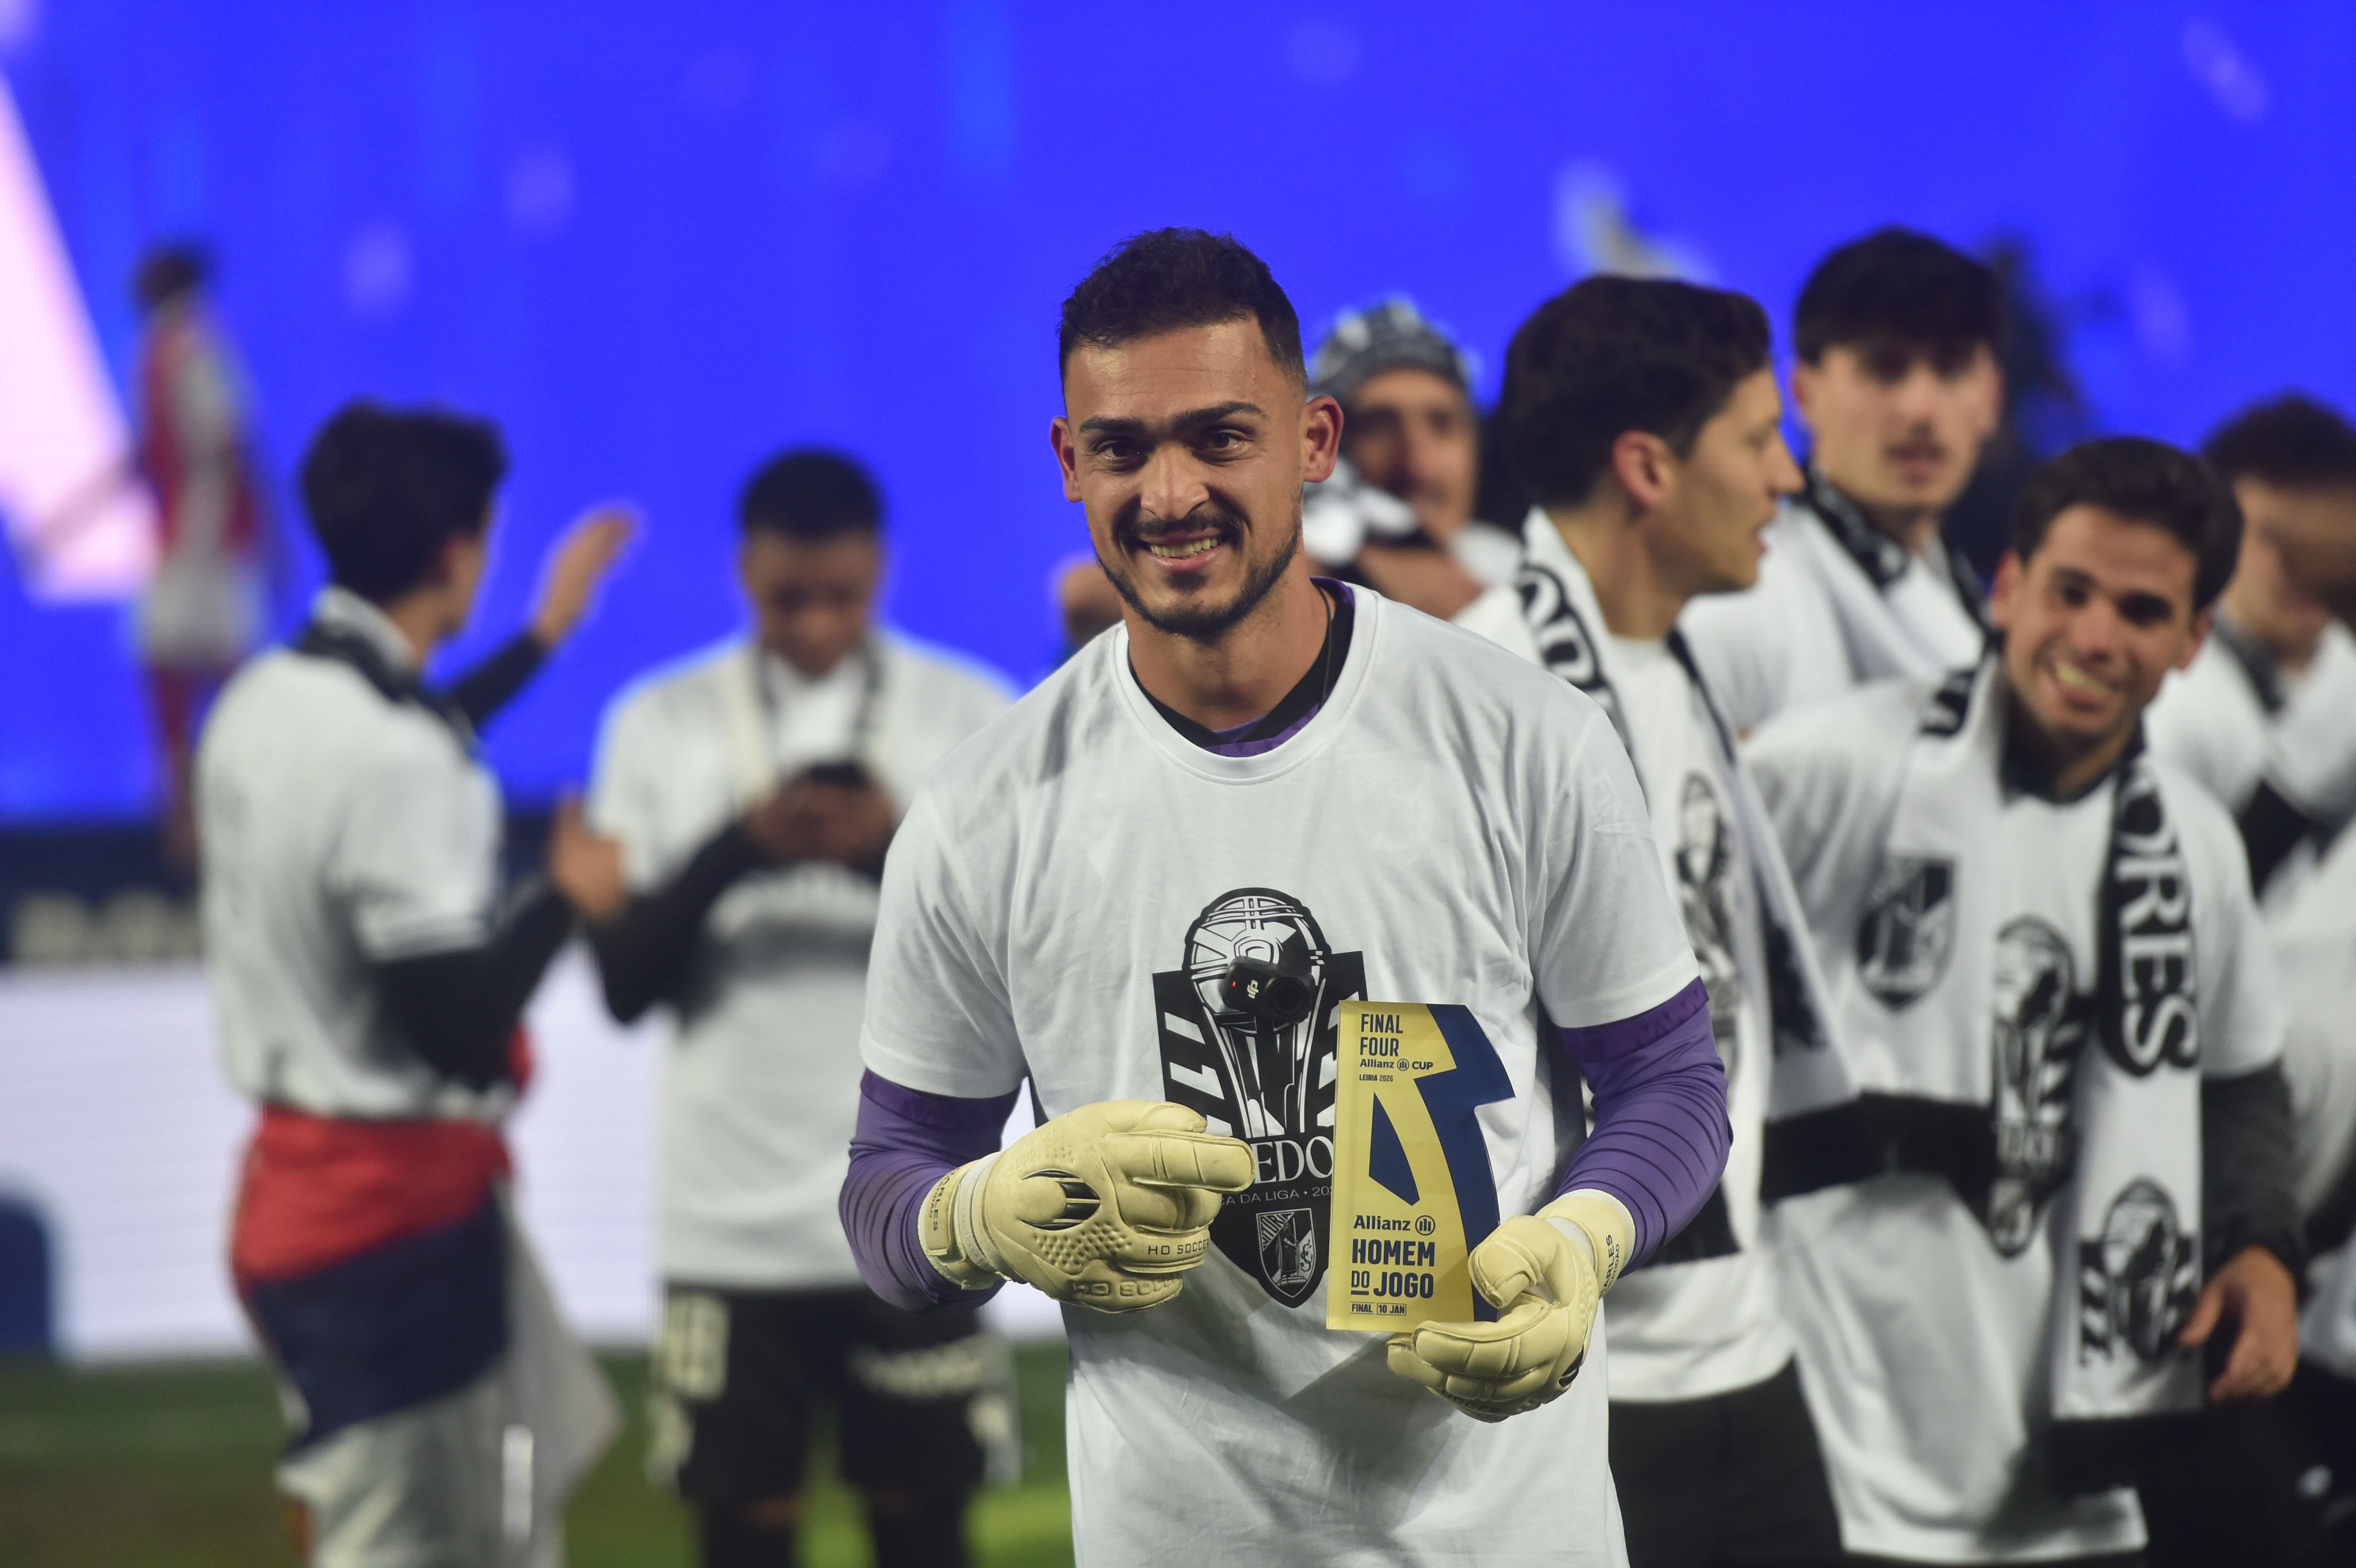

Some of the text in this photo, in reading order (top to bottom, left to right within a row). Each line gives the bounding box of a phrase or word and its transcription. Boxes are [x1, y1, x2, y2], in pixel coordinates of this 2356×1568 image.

[2116, 774, 2199, 1067] ORES
[1361, 1013, 1404, 1034] FINAL
[1360, 1037, 1399, 1056] FOUR
[1360, 1058, 1434, 1070] Allianz CUP
[1250, 1136, 1333, 1184] EDO
[1240, 1193, 1261, 1203] DA
[1266, 1189, 1299, 1201] LIGA
[1312, 1186, 1331, 1197] 20
[1353, 1215, 1411, 1231] Allianz
[1148, 1239, 1209, 1255] HO SOCCER
[1352, 1239, 1435, 1267] HOMEM
[1351, 1270, 1434, 1298] DO JOGO
[1352, 1304, 1405, 1314] FINAL 10 JAN
